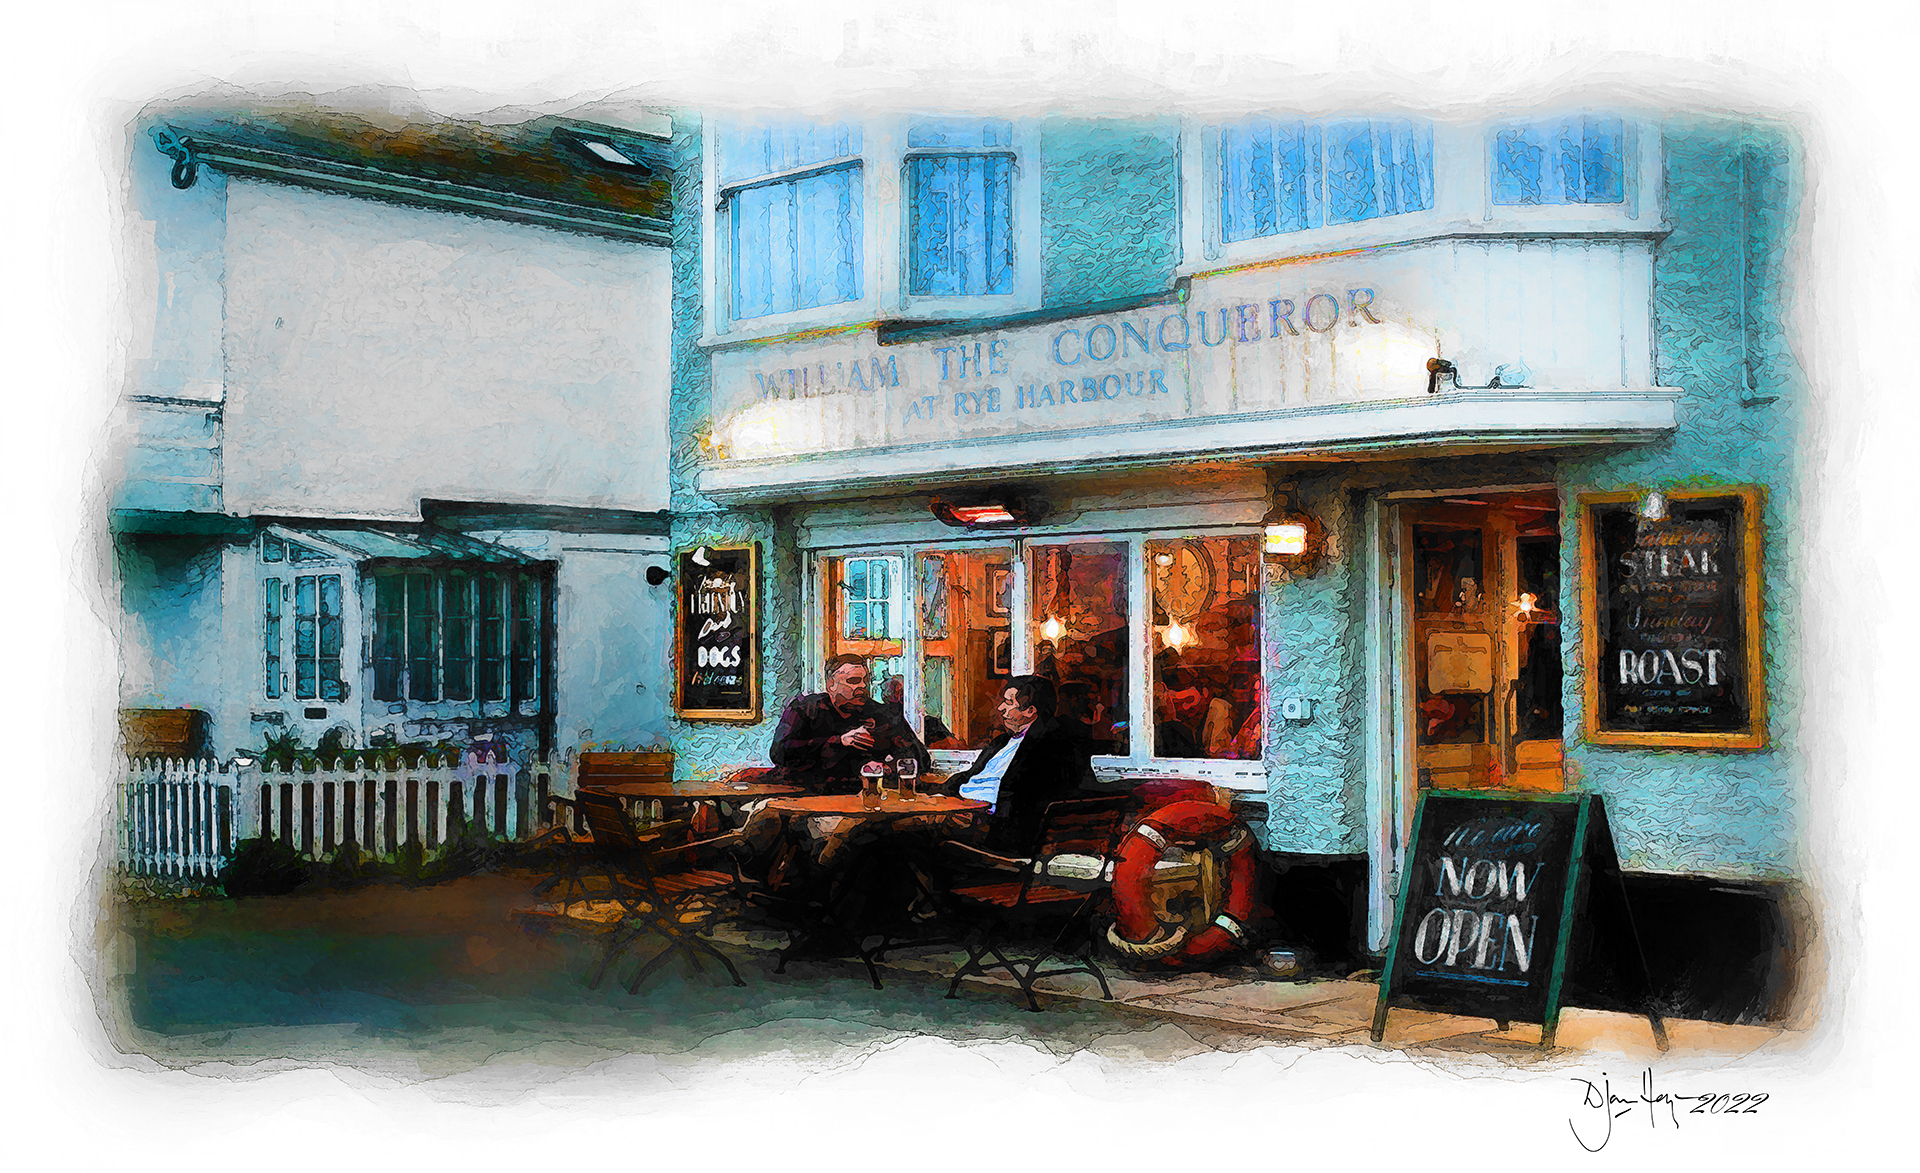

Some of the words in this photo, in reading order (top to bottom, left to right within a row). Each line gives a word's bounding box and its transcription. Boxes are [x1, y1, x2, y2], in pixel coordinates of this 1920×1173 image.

[755, 354, 900, 401] WILLIAM
[933, 338, 1009, 380] THE
[1052, 287, 1381, 366] CONQUEROR
[903, 395, 938, 424] AT
[953, 387, 1002, 416] RYE
[1016, 368, 1169, 410] HARBOUR
[1619, 548, 1721, 578] STEAK
[697, 645, 742, 668] DOGS
[1619, 647, 1723, 686] ROAST
[1434, 856, 1546, 902] NOW
[1414, 907, 1539, 973] OPEN
